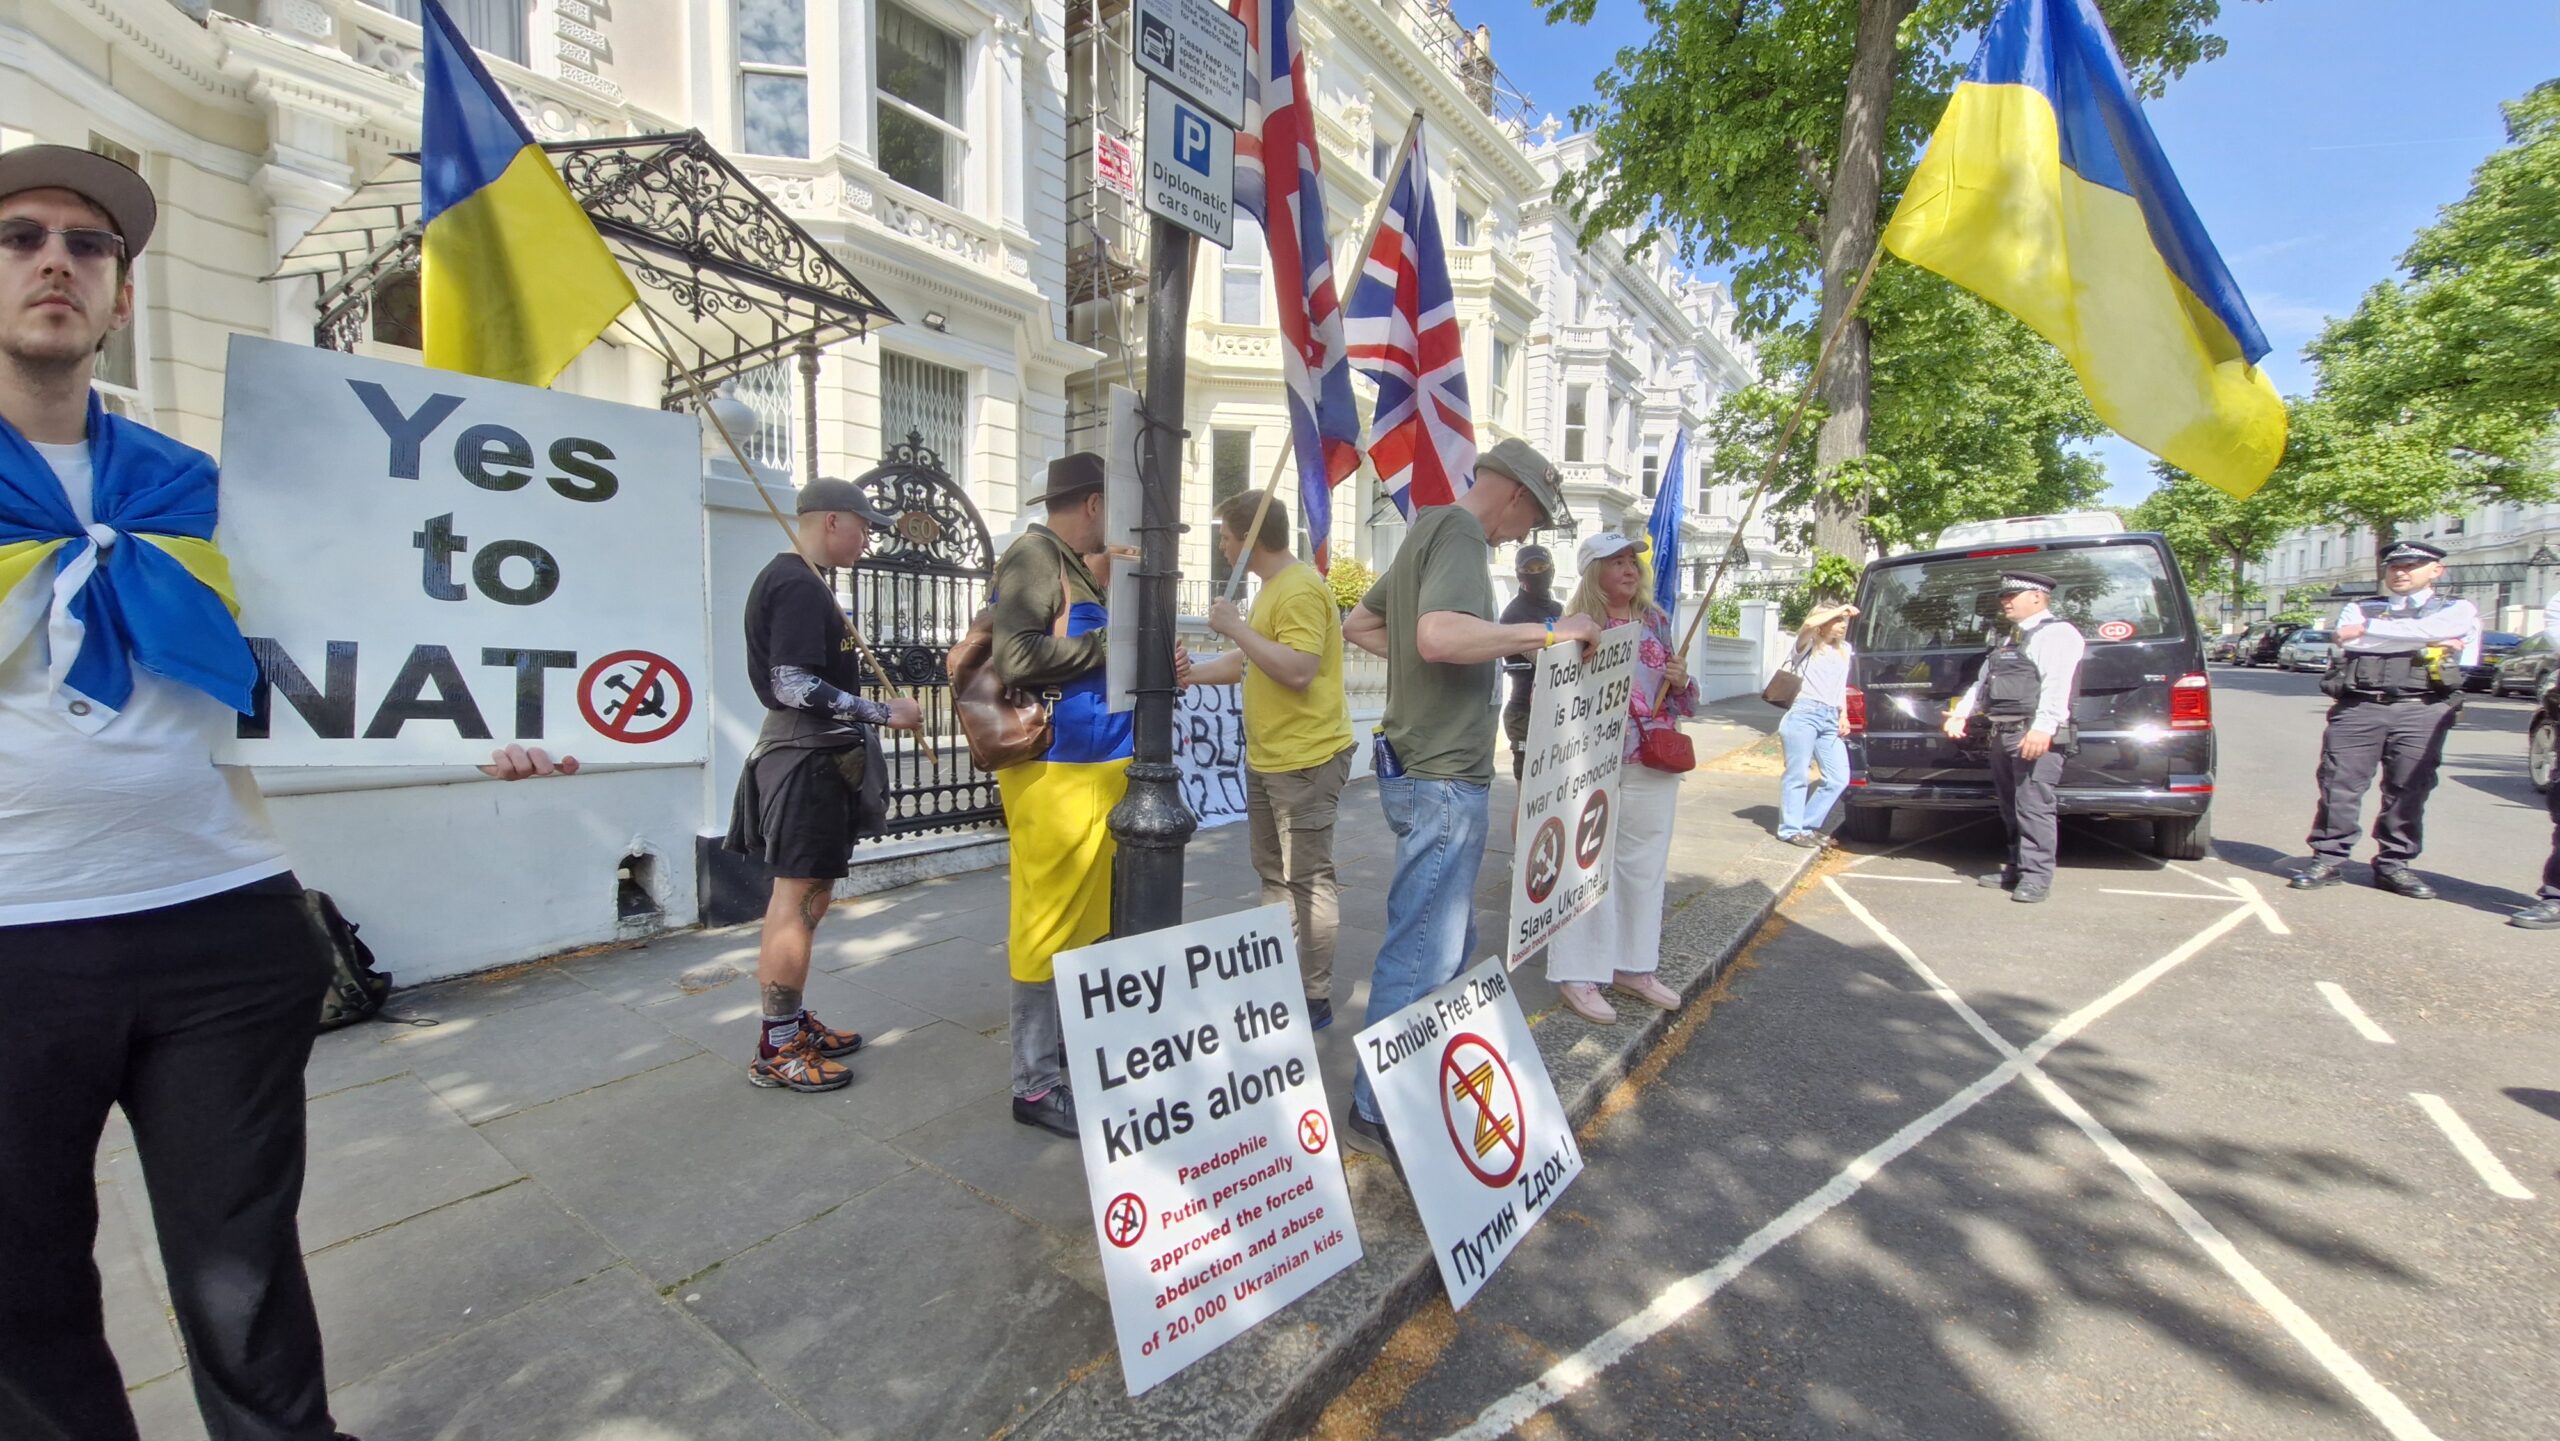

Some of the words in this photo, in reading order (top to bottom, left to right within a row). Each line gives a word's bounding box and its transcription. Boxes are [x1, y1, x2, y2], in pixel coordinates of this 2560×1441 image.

[1180, 9, 1189, 20] for
[1200, 25, 1221, 43] electric
[1223, 41, 1241, 56] vehicle
[1180, 32, 1203, 55] Please
[1205, 50, 1222, 68] keep
[1224, 63, 1237, 78] this
[1179, 67, 1187, 79] to
[1179, 59, 1206, 80] electric
[1208, 76, 1232, 97] vehicle
[1180, 46, 1200, 65] space
[1203, 60, 1217, 76] free
[1220, 71, 1229, 83] for
[1231, 81, 1240, 91] an
[1153, 161, 1228, 214] Diplomatic
[1158, 191, 1188, 216] cars
[1193, 209, 1221, 234] only
[345, 378, 619, 502] Yes
[908, 516, 931, 539] 60
[413, 511, 560, 606] to
[2104, 625, 2127, 636] CD
[1554, 702, 1565, 727] is
[1571, 694, 1594, 722] Day
[1595, 675, 1631, 716] 1529
[1531, 749, 1546, 777] of
[1549, 731, 1590, 770] Putin's
[1526, 790, 1553, 820] war
[1556, 776, 1570, 803] of
[1572, 752, 1619, 800] genocide
[1520, 907, 1553, 944] Slava
[1078, 965, 1166, 1020] Hey
[1184, 930, 1284, 990] Putin
[1095, 1023, 1220, 1092] Leave
[1233, 1000, 1290, 1043] the
[1368, 1011, 1439, 1074] Zombie
[1433, 994, 1473, 1032] Free
[1468, 972, 1507, 1011] Zone
[1101, 1097, 1195, 1164] kids
[1207, 1057, 1306, 1120] alone
[1177, 1133, 1268, 1186] Paedophile
[1160, 1195, 1208, 1230] Putin
[1212, 1154, 1294, 1210] personally
[1149, 1218, 1232, 1274] approved
[1236, 1203, 1263, 1228] the
[1266, 1175, 1315, 1212] forced
[1450, 1200, 1519, 1287] Путин
[1154, 1250, 1244, 1310] abduction
[1248, 1228, 1277, 1257] and
[1281, 1205, 1326, 1242] abuse
[1141, 1331, 1161, 1357] of
[1165, 1294, 1228, 1344] 20,000
[1232, 1250, 1311, 1302] Ukrainian
[1313, 1227, 1345, 1256] kids
